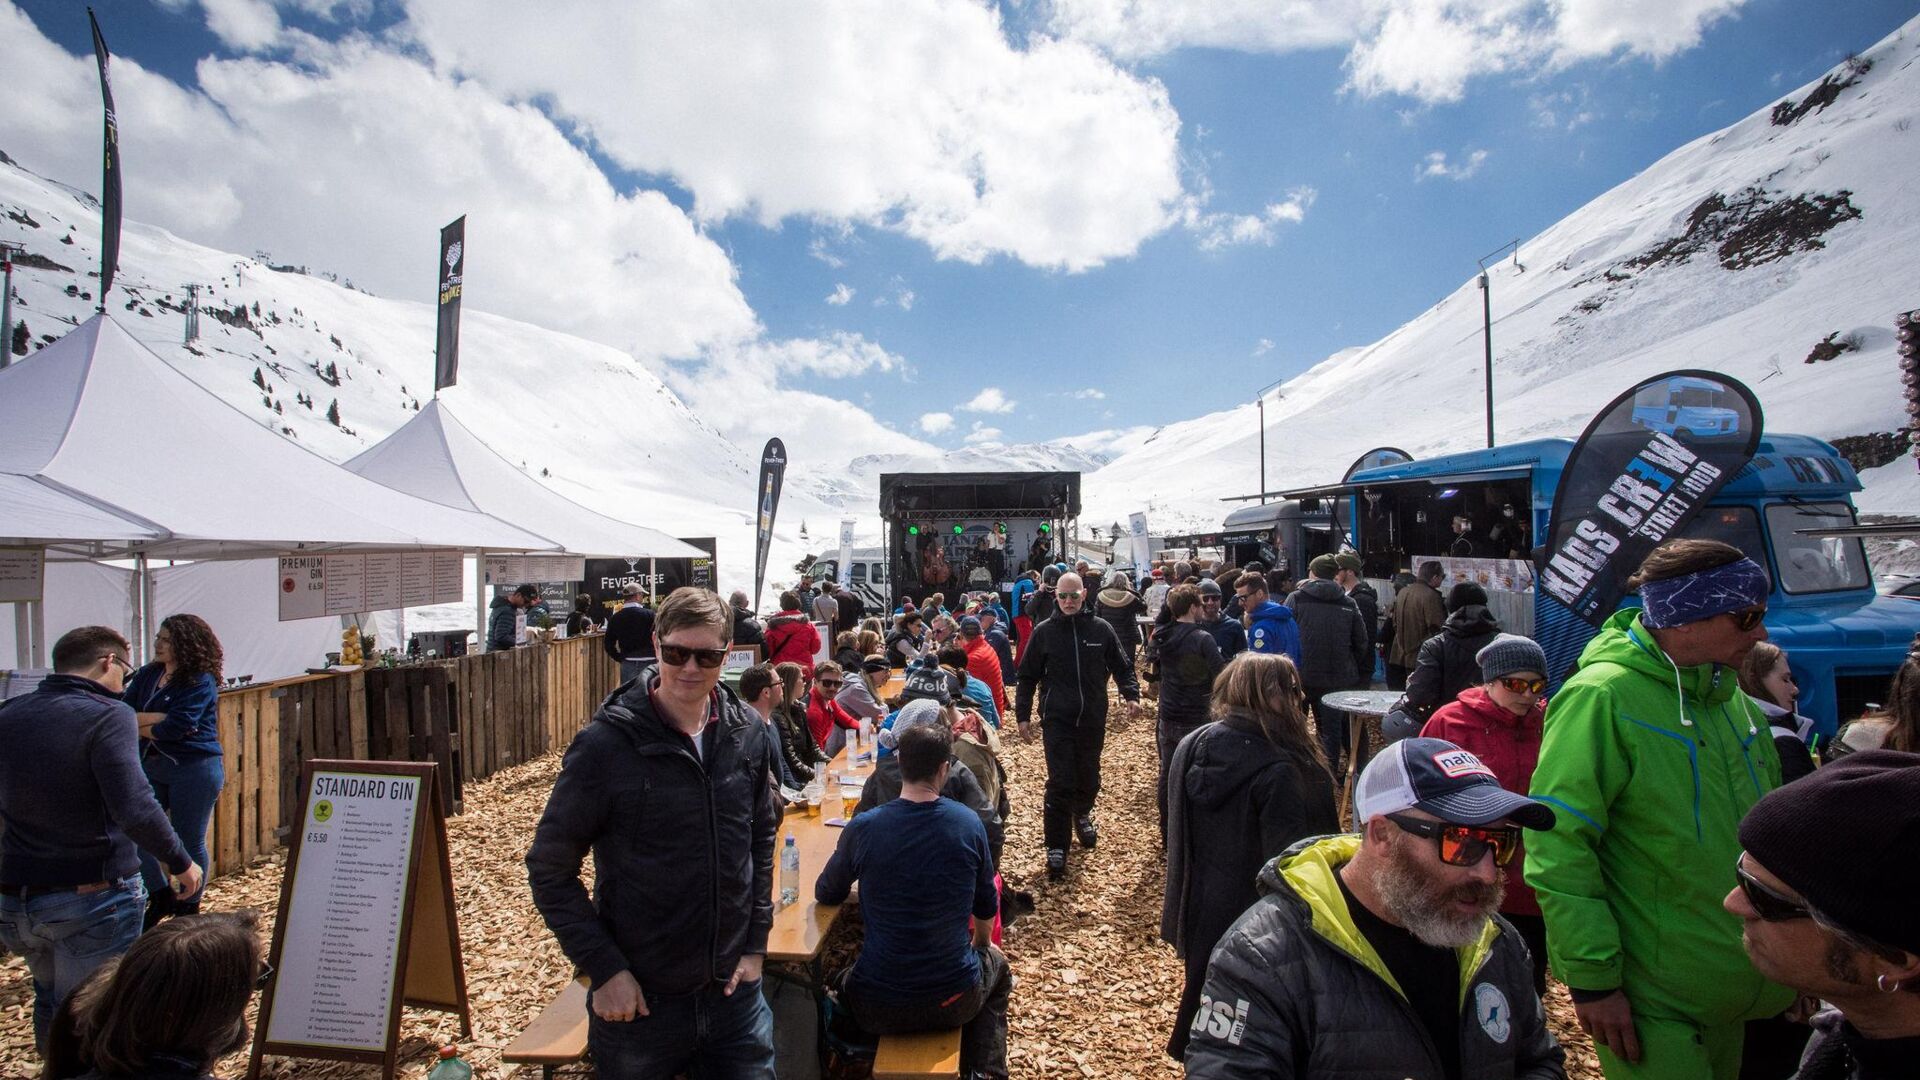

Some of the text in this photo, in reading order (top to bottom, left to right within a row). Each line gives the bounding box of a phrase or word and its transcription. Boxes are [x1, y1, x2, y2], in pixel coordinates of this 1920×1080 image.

[1639, 460, 1722, 542] STREET FOOD
[281, 557, 323, 569] PREMIUM
[310, 569, 323, 579] GIN
[738, 652, 750, 661] GIN
[315, 777, 414, 801] STANDARD GIN
